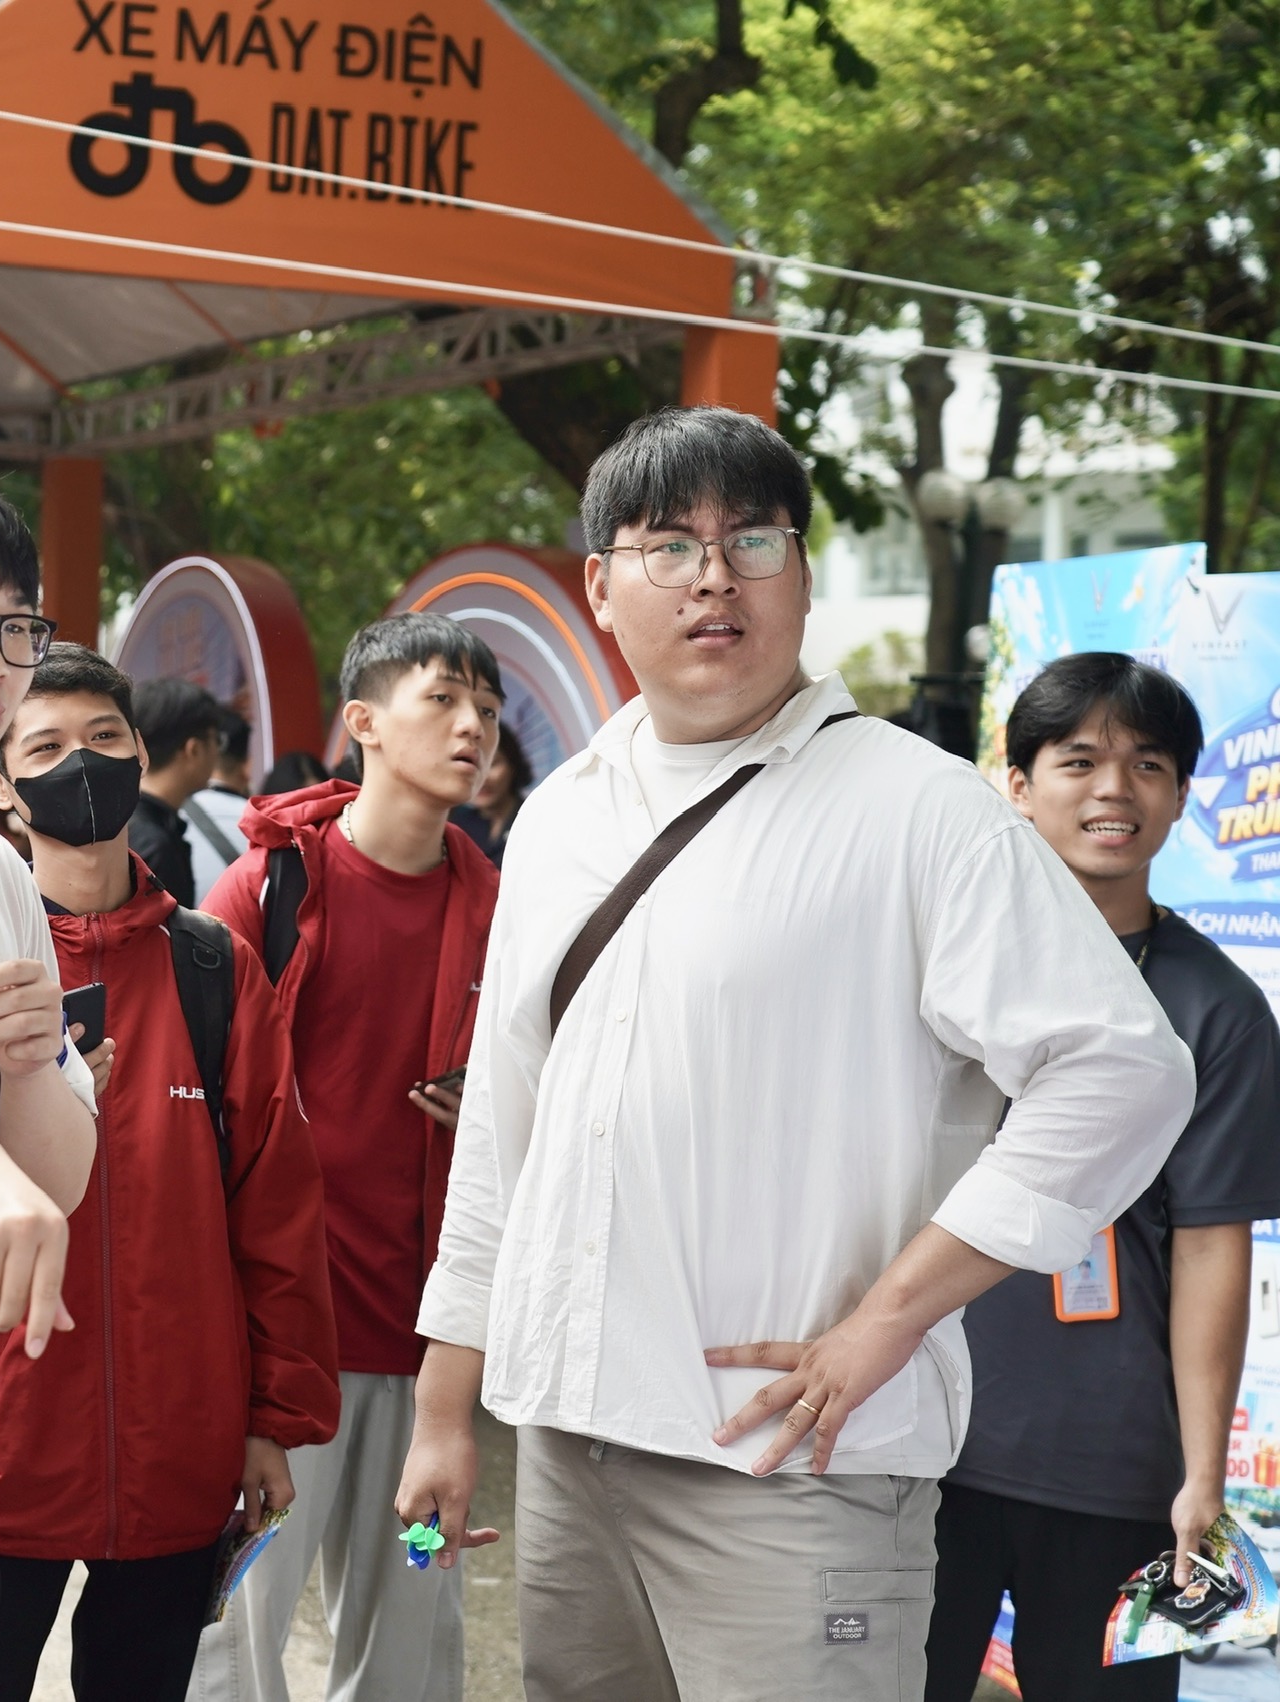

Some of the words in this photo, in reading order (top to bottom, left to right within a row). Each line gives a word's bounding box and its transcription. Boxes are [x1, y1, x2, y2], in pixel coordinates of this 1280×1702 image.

[73, 0, 158, 60] XE
[175, 0, 319, 74] MÁY
[333, 12, 484, 99] ĐIỆN
[268, 102, 479, 210] DAT.BIKE
[1223, 724, 1280, 770] VIN
[828, 1626, 840, 1634] THE
